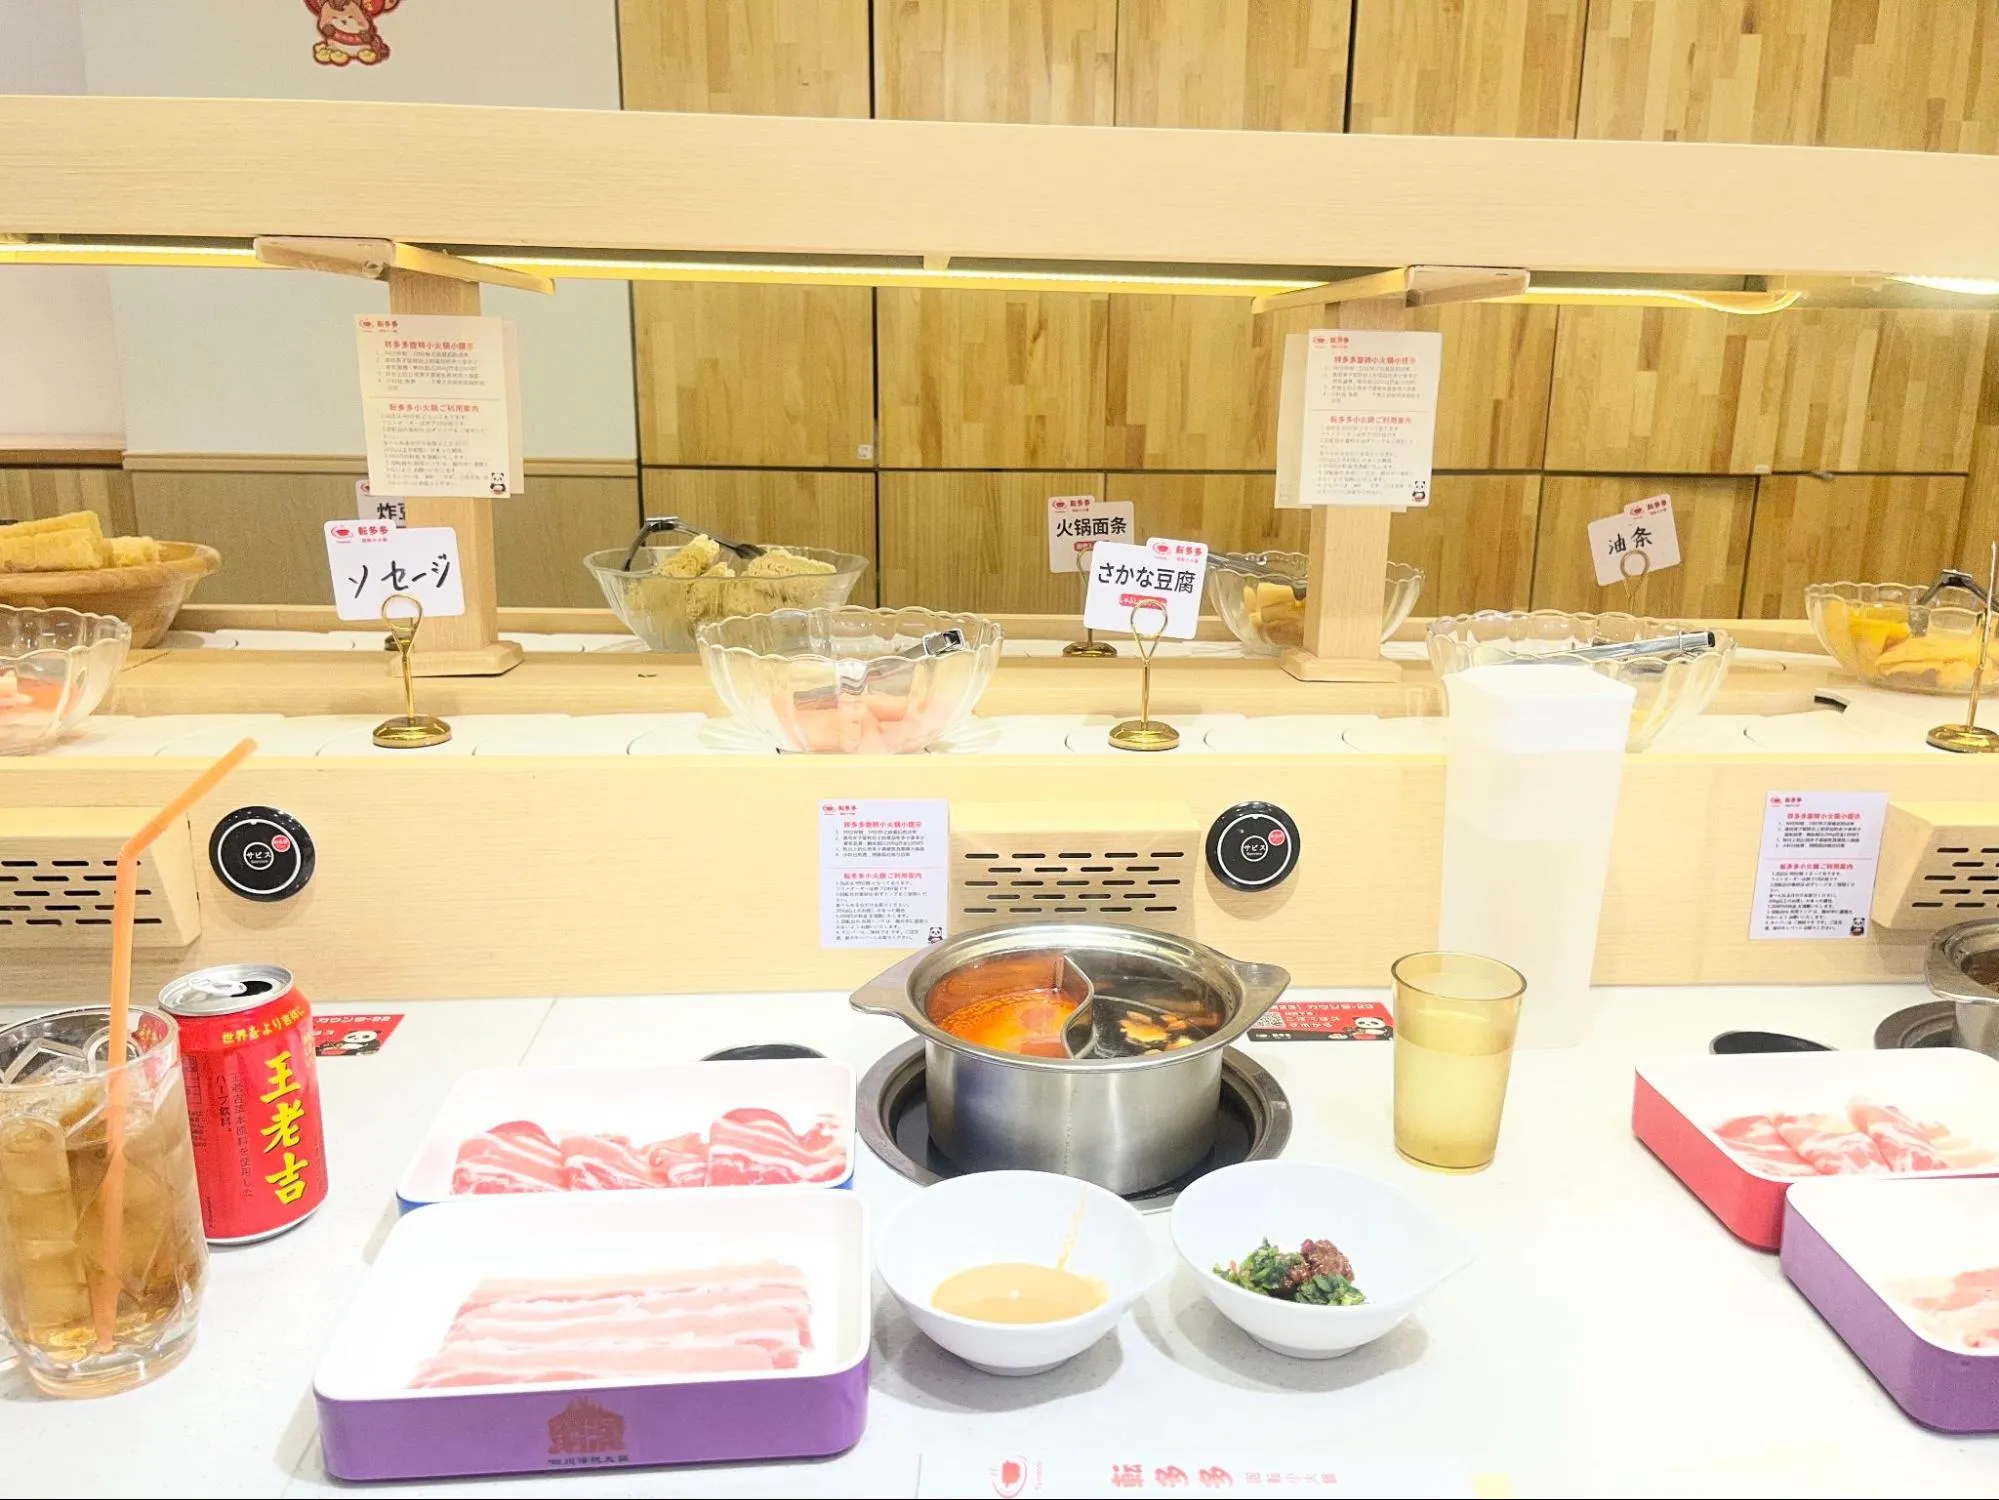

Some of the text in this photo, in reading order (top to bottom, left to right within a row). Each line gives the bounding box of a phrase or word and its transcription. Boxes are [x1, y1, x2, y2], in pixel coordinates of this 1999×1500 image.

[1056, 516, 1127, 538] 火锅面条
[1608, 526, 1653, 555] 油条
[348, 553, 450, 599] ソセージ
[1097, 562, 1197, 594] さかな豆腐
[259, 1050, 309, 1204] 王老吉
